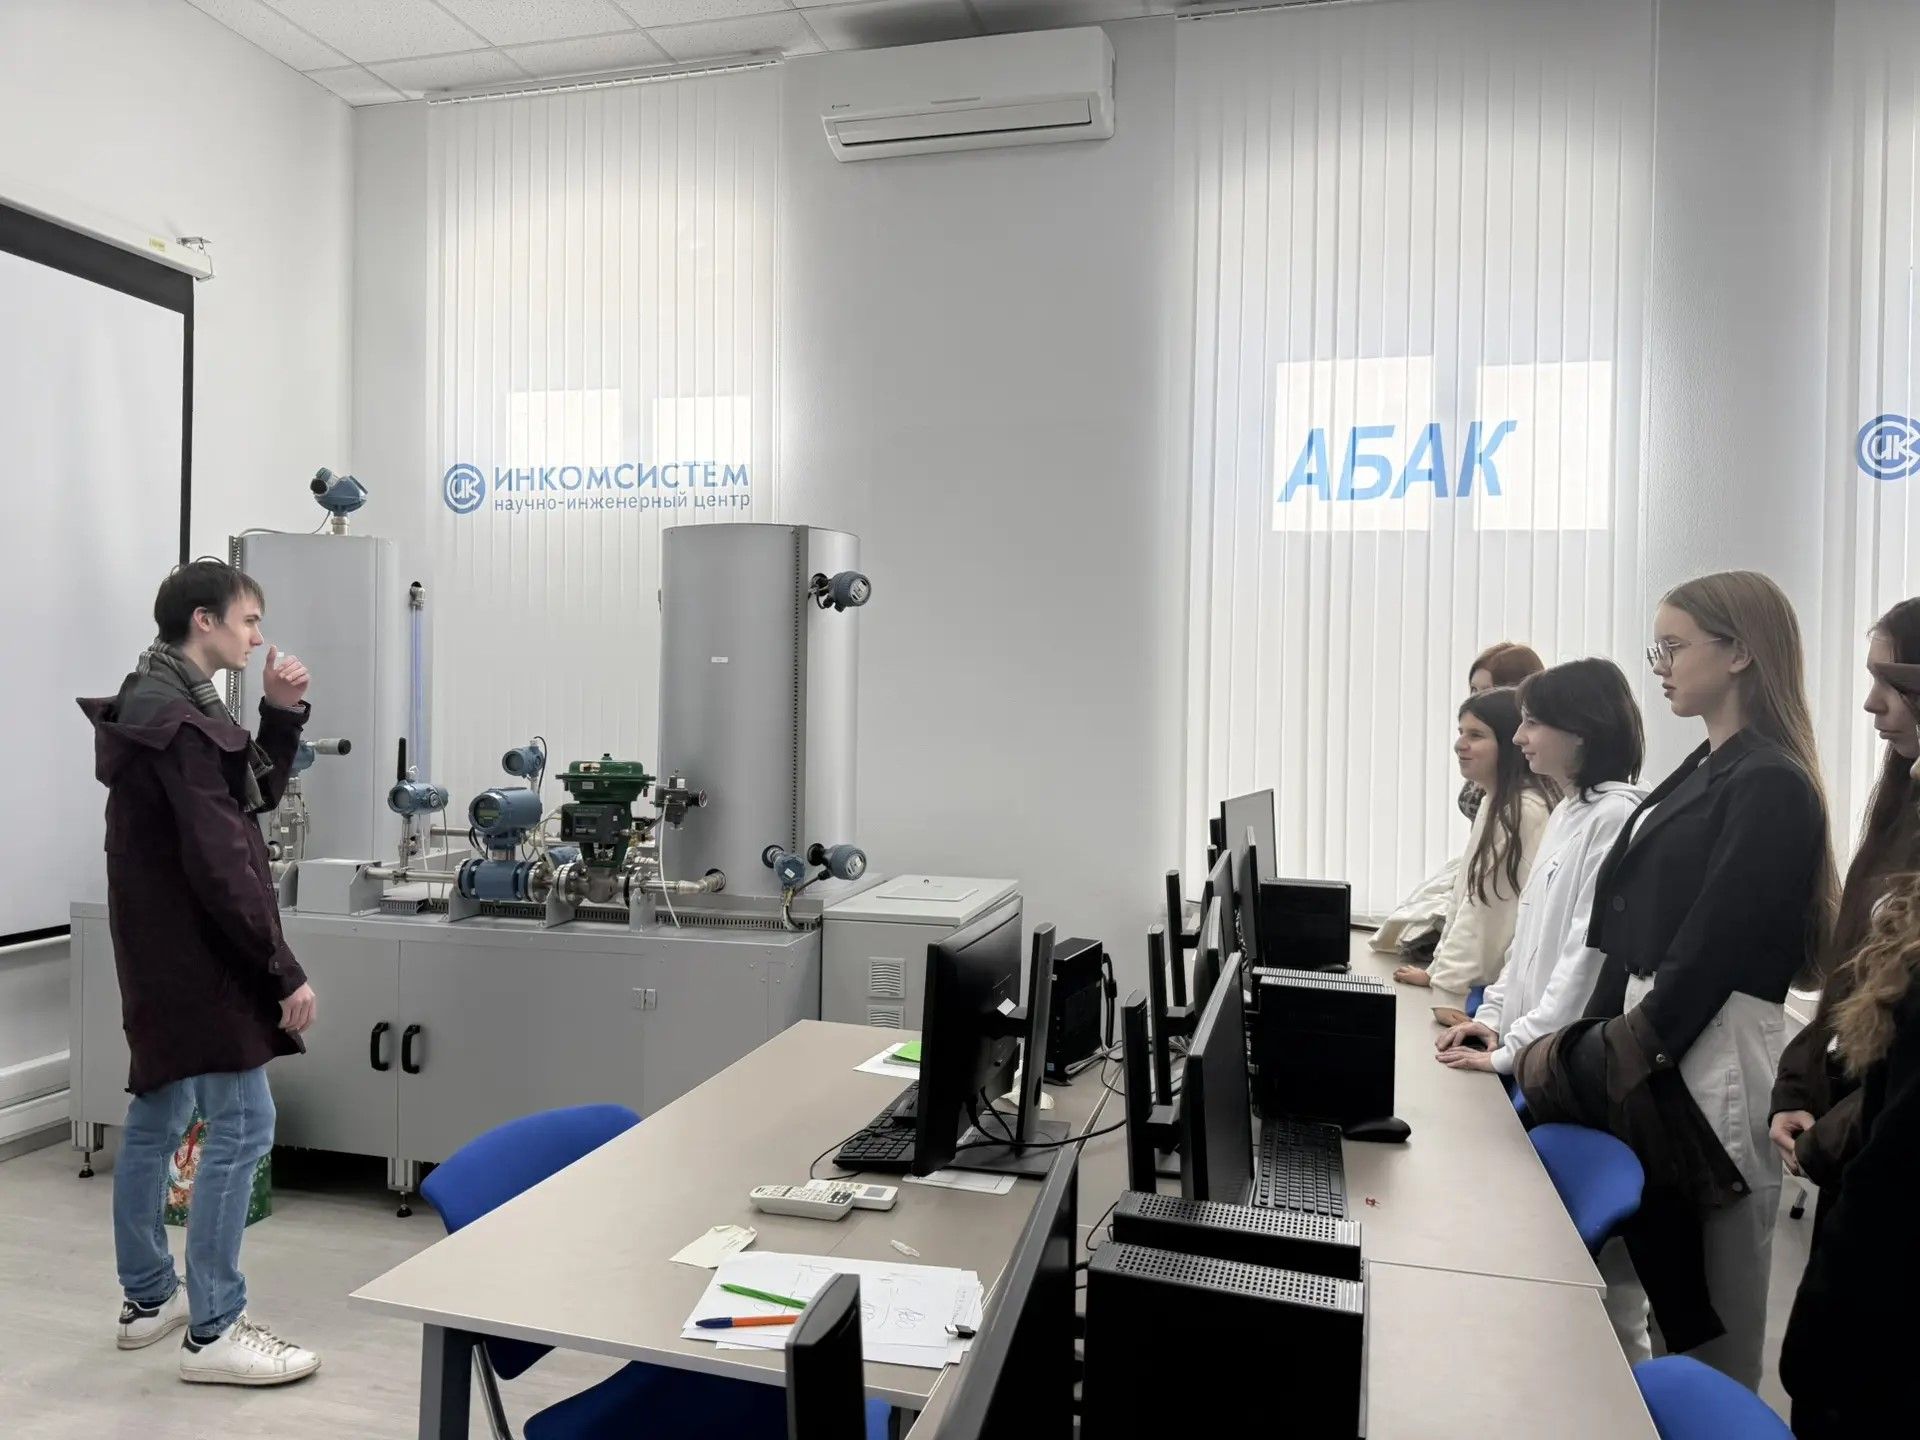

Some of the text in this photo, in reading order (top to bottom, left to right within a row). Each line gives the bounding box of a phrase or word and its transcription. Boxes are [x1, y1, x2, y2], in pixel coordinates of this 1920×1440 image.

[494, 461, 749, 491] ИНКОМСИСТЕМ
[1277, 420, 1518, 502] АБАК
[494, 492, 750, 513] научно-инженерный центр
